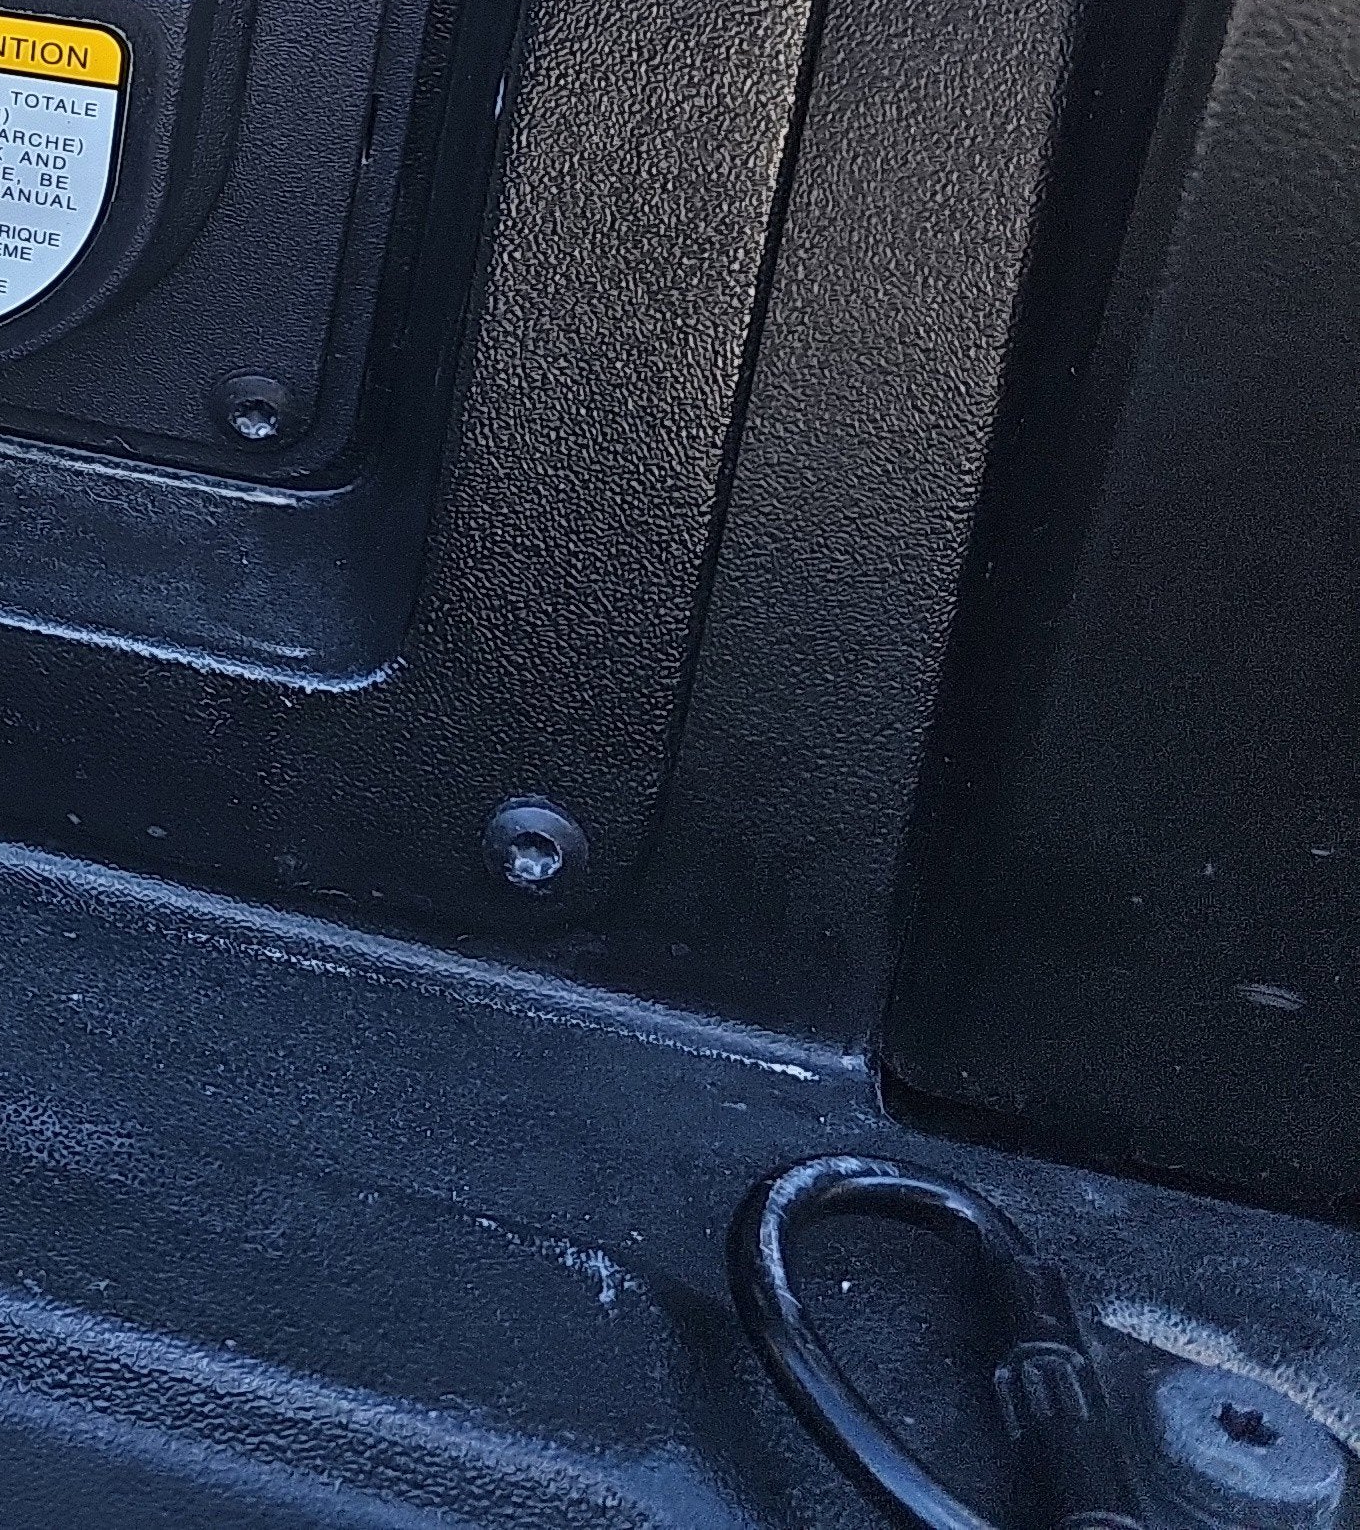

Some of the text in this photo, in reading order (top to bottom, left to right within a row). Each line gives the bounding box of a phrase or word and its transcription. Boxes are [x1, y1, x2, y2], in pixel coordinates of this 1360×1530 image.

[10, 90, 98, 118] TOTALE
[18, 150, 67, 171] AND
[39, 172, 70, 191] BE
